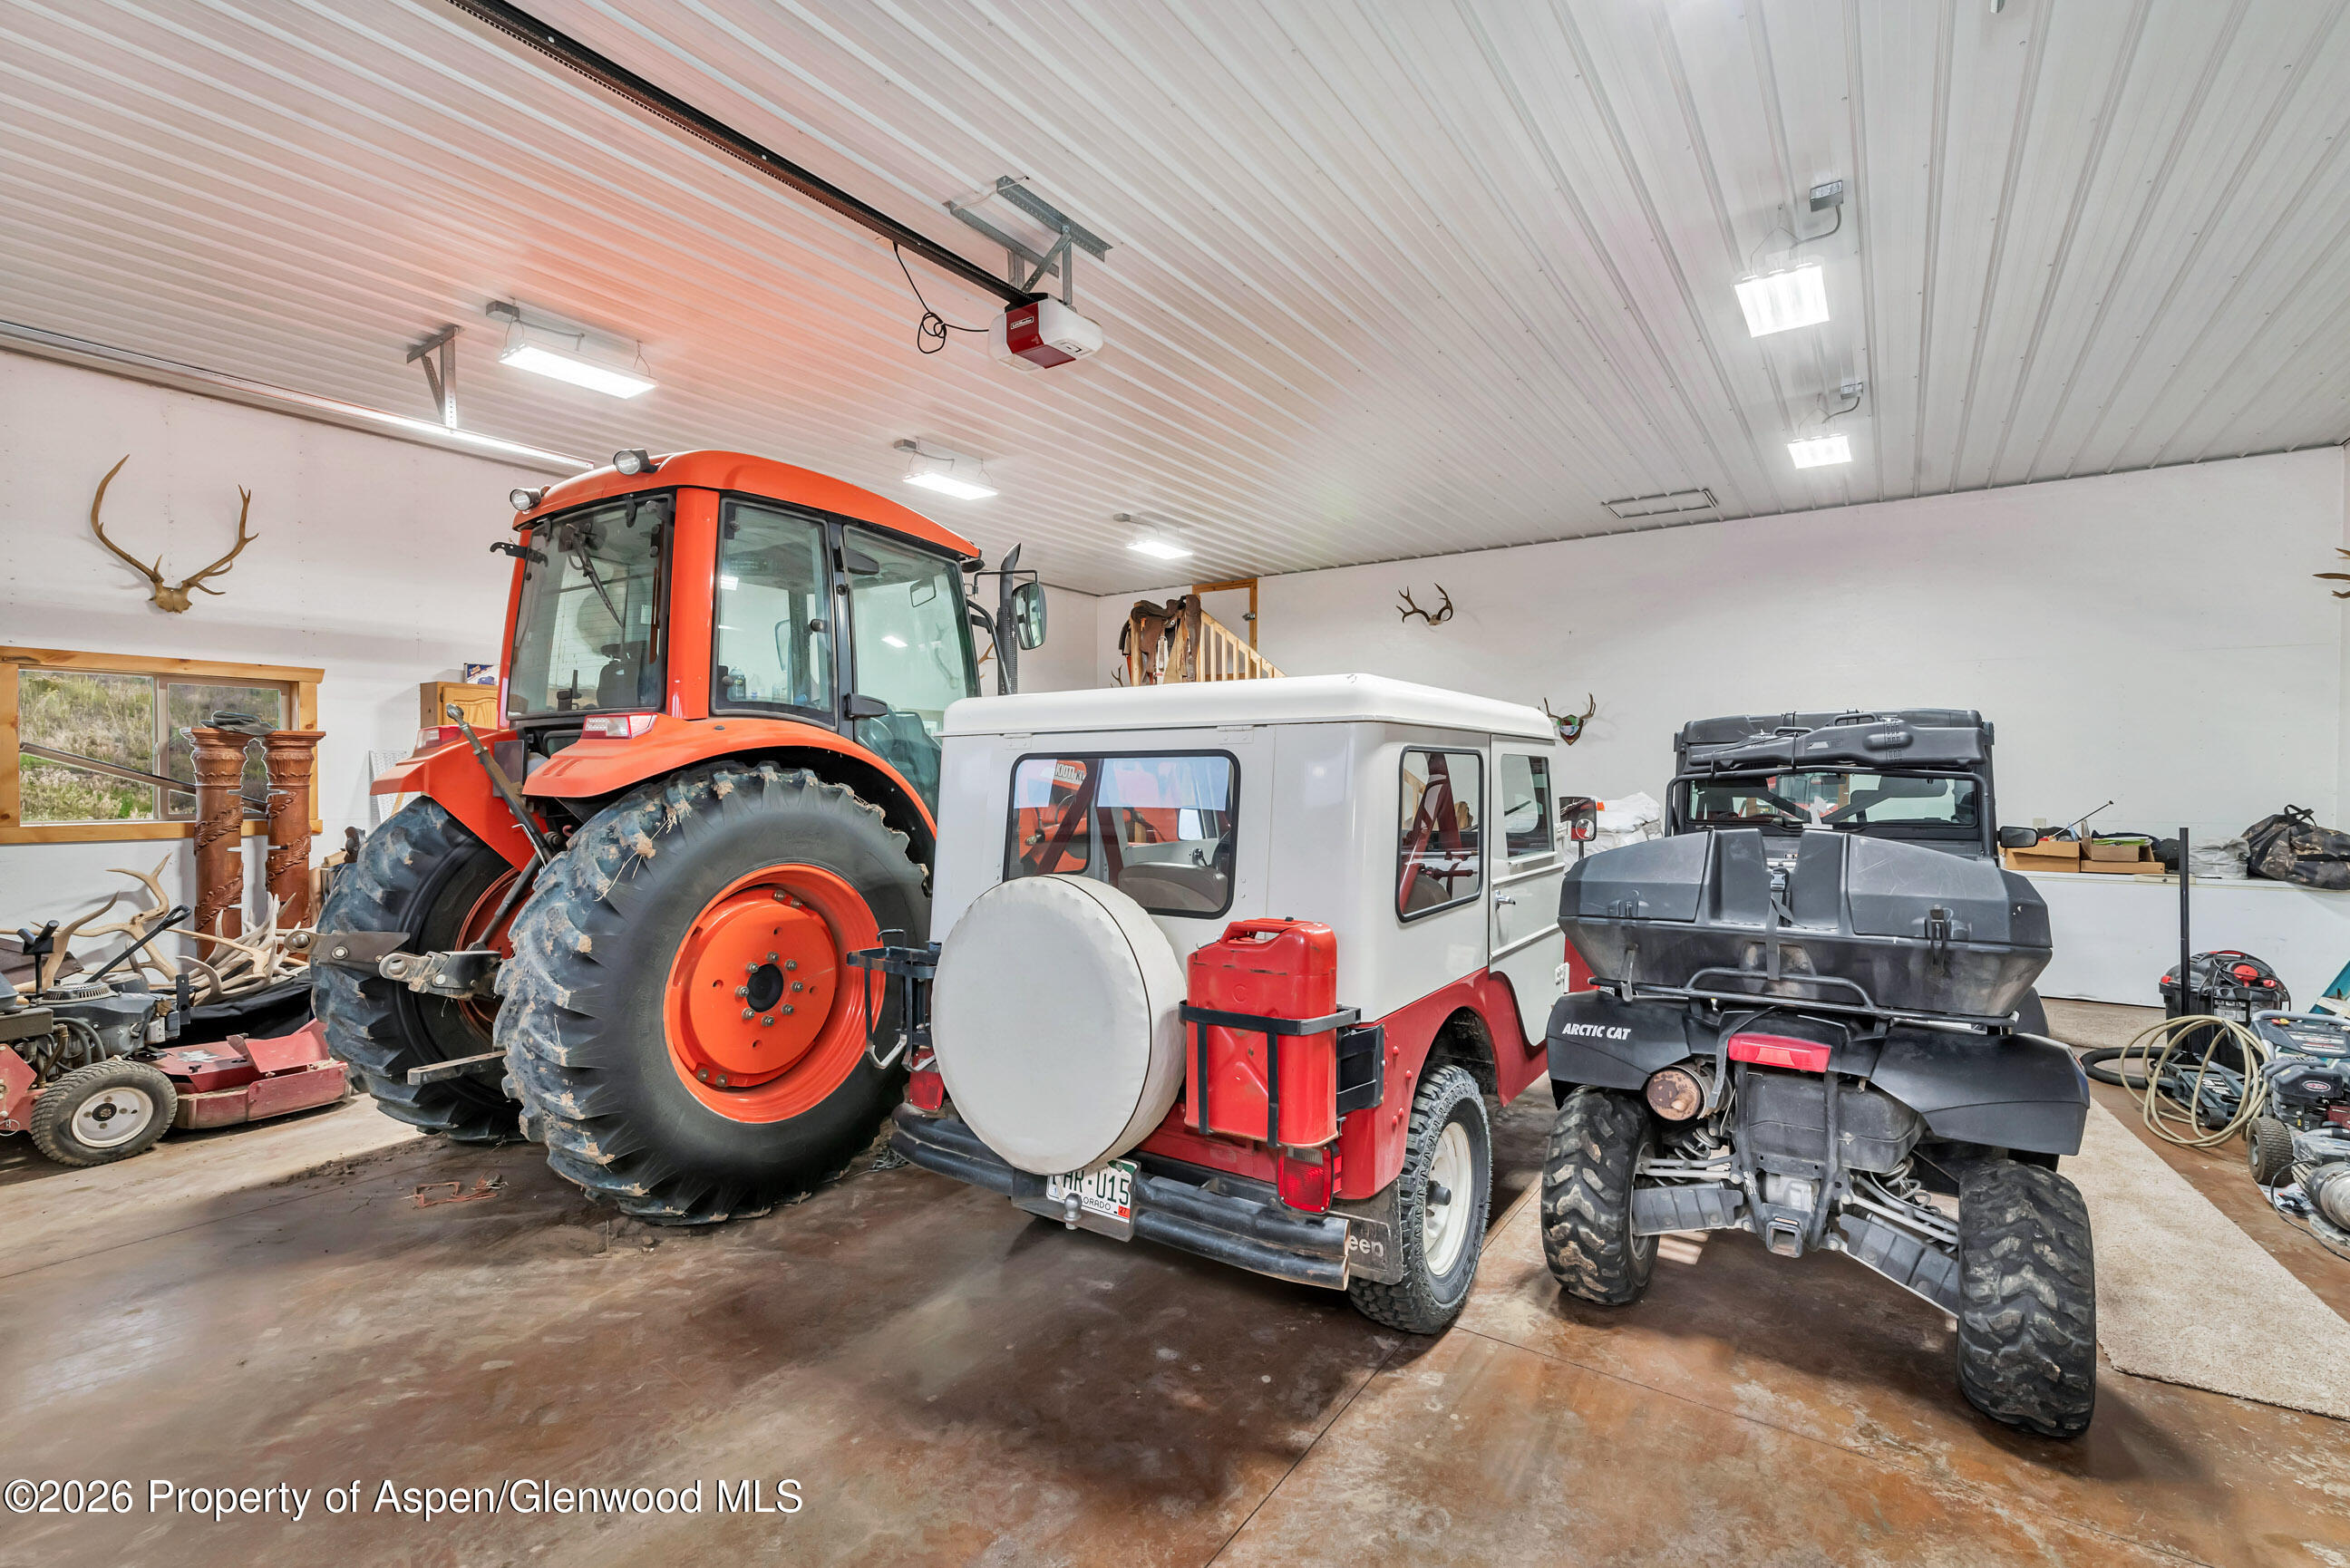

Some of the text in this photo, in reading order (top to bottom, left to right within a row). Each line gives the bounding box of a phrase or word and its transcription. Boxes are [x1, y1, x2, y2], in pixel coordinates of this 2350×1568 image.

[1562, 1022, 1632, 1040] ARCTIC CAT
[1083, 1196, 1112, 1211] ORADO
[1348, 1234, 1384, 1261] eep
